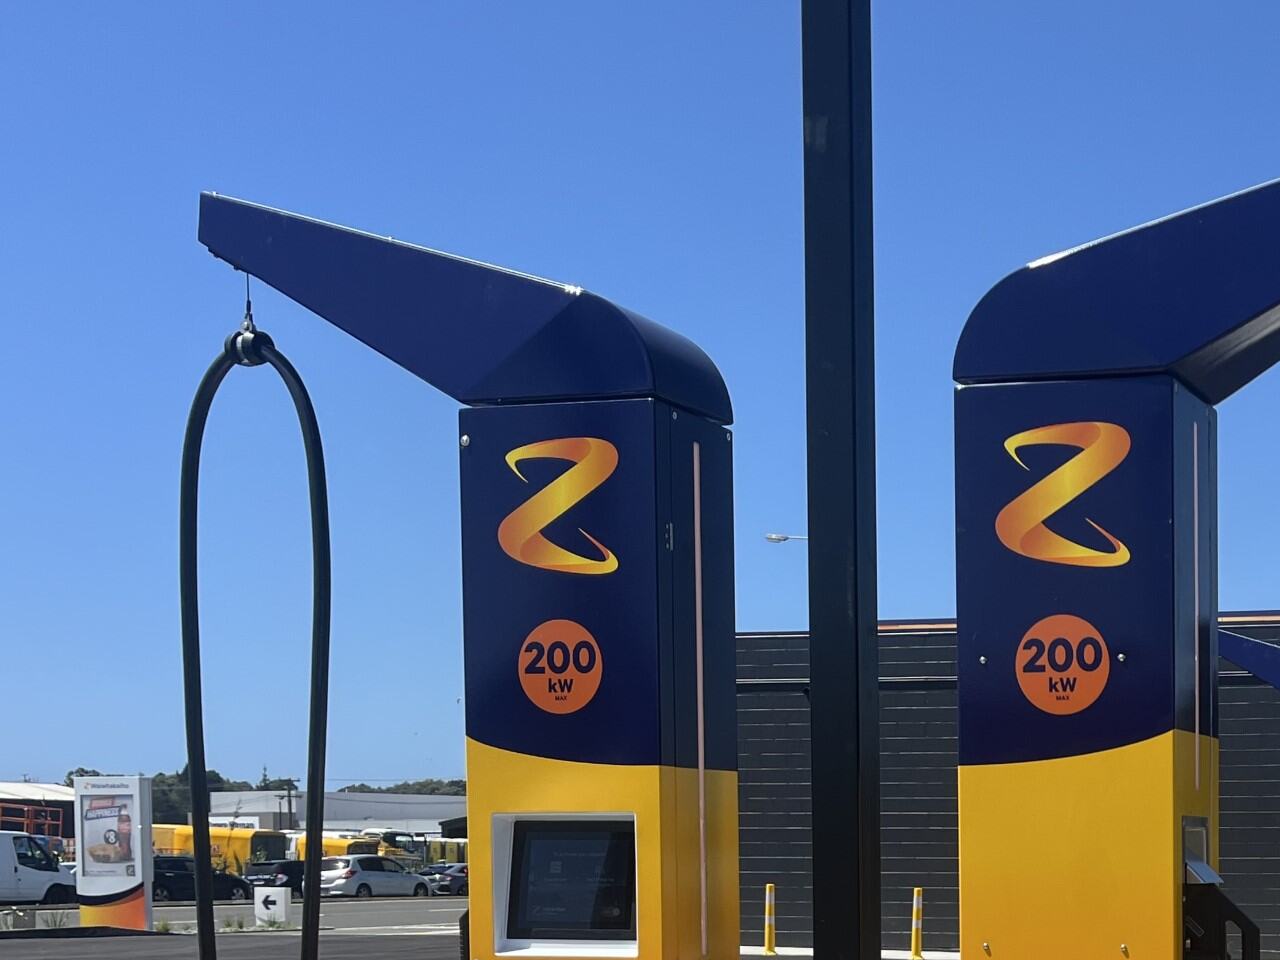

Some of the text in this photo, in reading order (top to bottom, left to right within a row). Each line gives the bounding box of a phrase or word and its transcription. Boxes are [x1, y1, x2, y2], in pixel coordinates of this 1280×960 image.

[498, 437, 619, 574] Z
[995, 421, 1131, 567] Z
[524, 640, 596, 674] 200
[1022, 636, 1103, 673] 200
[548, 678, 573, 693] kW
[1049, 677, 1077, 692] kW
